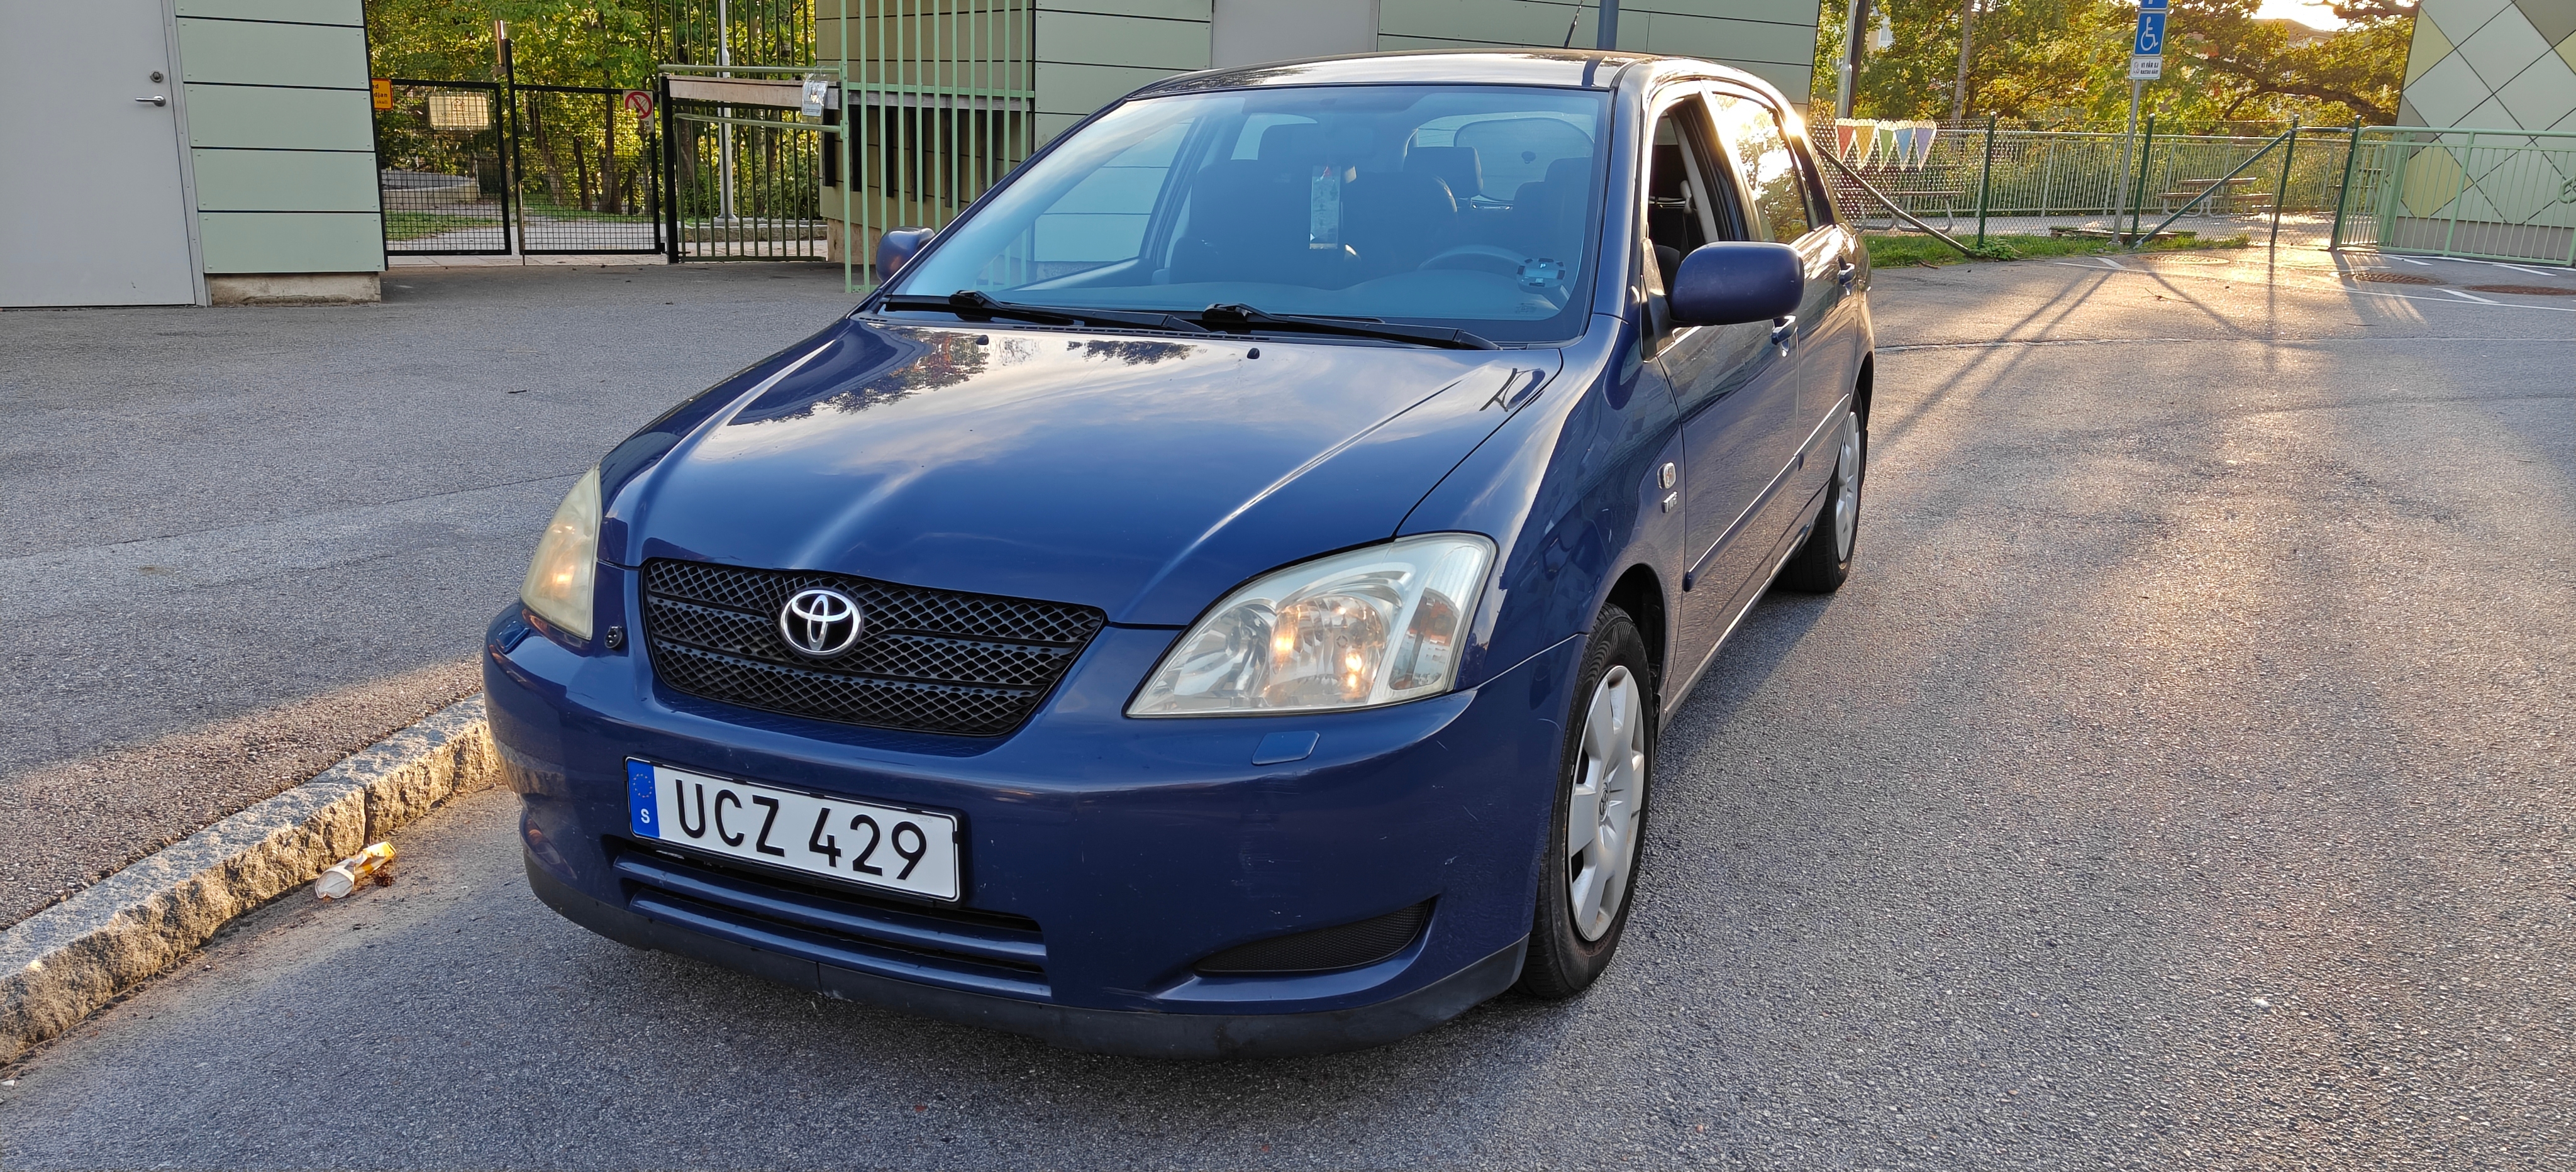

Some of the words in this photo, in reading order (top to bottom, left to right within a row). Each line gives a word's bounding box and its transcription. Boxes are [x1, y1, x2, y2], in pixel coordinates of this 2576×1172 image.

[641, 808, 650, 824] S
[675, 778, 785, 858] UCZ
[808, 807, 928, 880] 429
